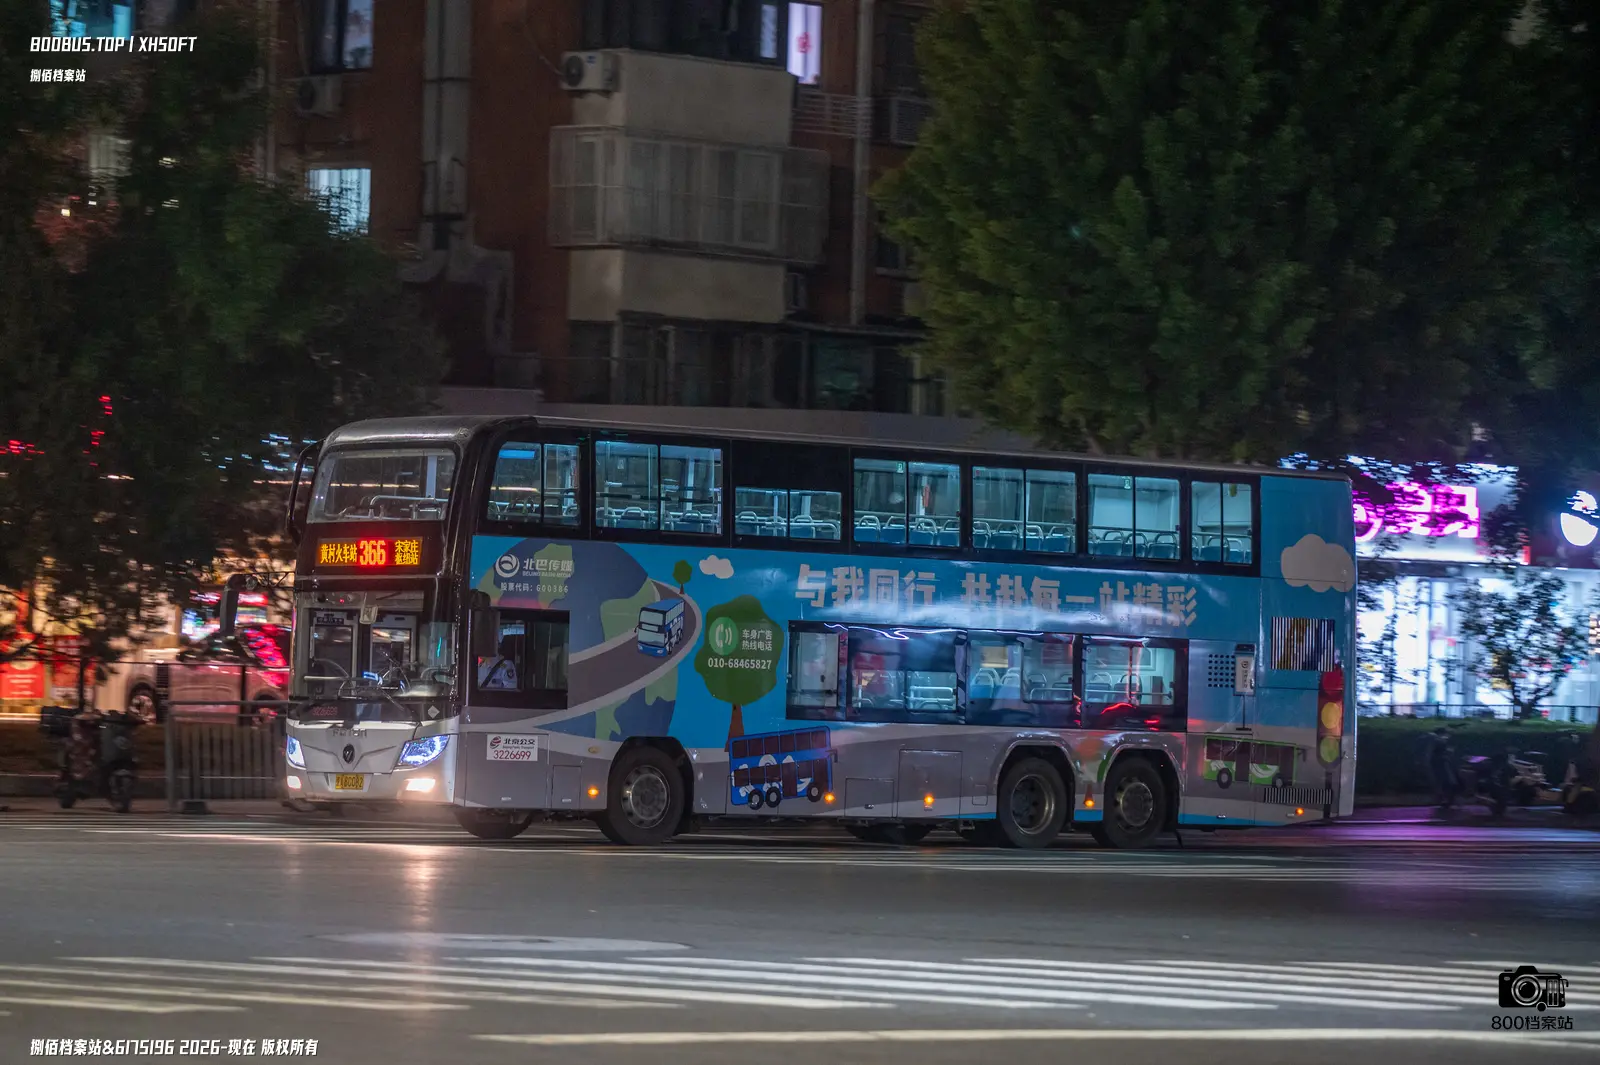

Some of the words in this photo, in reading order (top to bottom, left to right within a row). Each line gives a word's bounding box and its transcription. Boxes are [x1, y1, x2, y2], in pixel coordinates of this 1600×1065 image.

[360, 540, 386, 565] 366
[395, 540, 418, 553] 宋家庄
[320, 543, 357, 564] 黄村火车站
[523, 558, 573, 571] 北巴传媒
[536, 584, 568, 593] 600386
[795, 563, 936, 613] 与我同行
[961, 572, 1197, 628] 共赴每一站精彩
[742, 629, 772, 640] 车身广告
[742, 640, 772, 651] 热线电话
[707, 657, 772, 669] 010-68465827
[493, 750, 531, 760] 3226699
